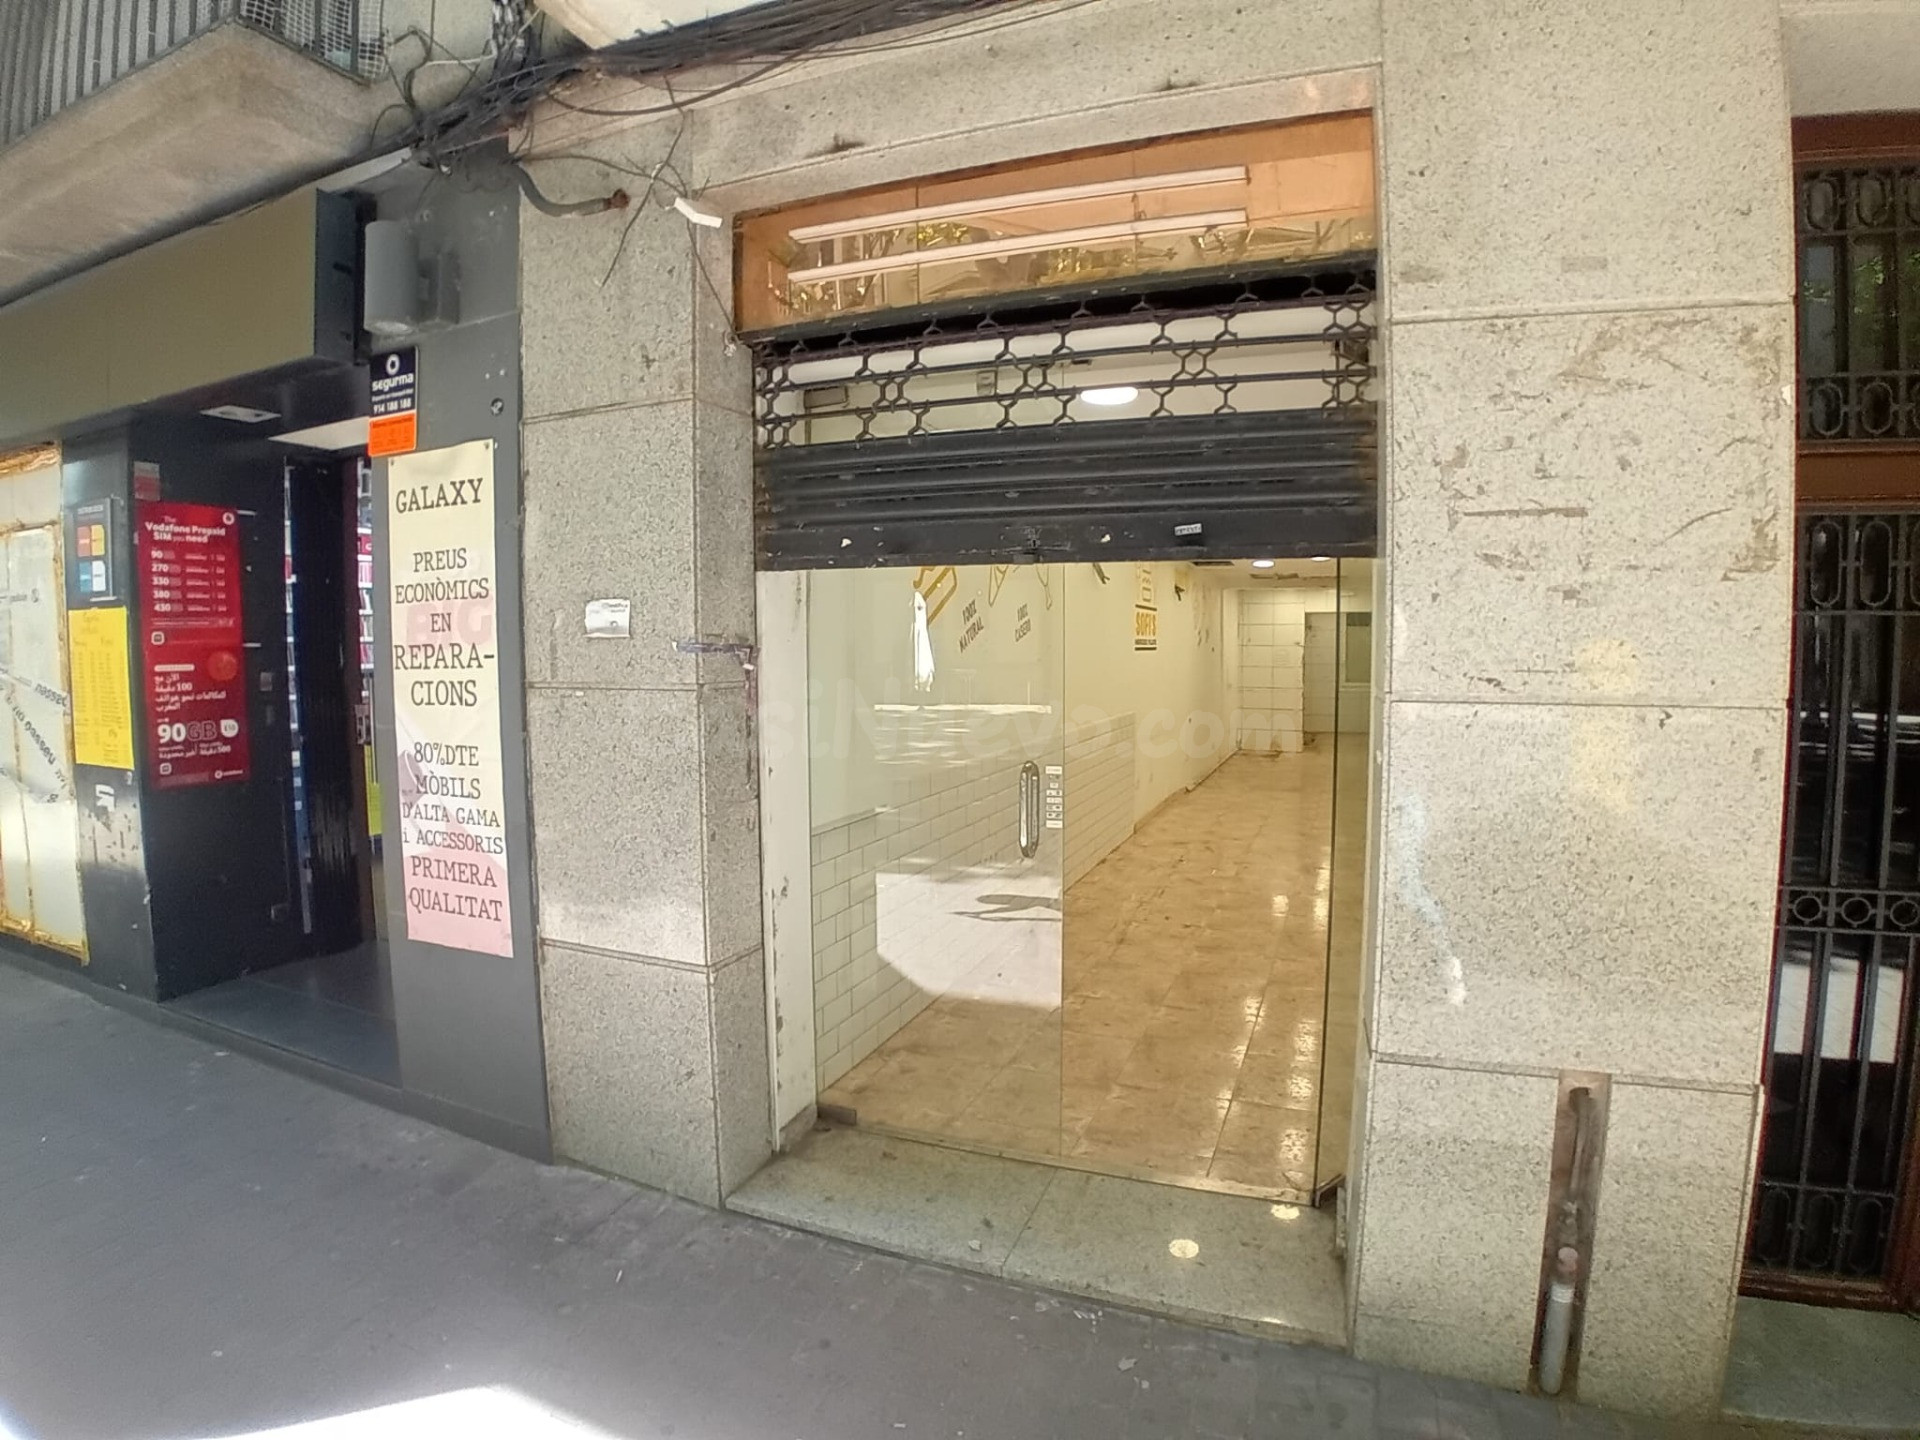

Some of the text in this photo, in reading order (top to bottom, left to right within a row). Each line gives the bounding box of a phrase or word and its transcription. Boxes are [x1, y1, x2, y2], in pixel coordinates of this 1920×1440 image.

[371, 373, 414, 392] segurma
[373, 404, 385, 414] 914
[396, 477, 483, 514] GALAXY
[145, 522, 226, 536] Vodafone Prepaid
[154, 532, 172, 540] SIM
[186, 534, 209, 543] need
[413, 547, 467, 573] PREUS
[395, 577, 489, 604] ECONÒMICS
[430, 612, 452, 633] EN
[959, 616, 984, 654] NATURAL
[394, 642, 495, 671] REPARA-
[177, 682, 192, 691] 100
[411, 679, 477, 707] CIONS
[416, 770, 480, 800] MÒBILS
[402, 802, 500, 828] D'ALTA GAMA
[403, 828, 504, 855] i ACCESSORIS
[410, 855, 498, 888] PRIMERA
[408, 886, 502, 922] QUALITAT
